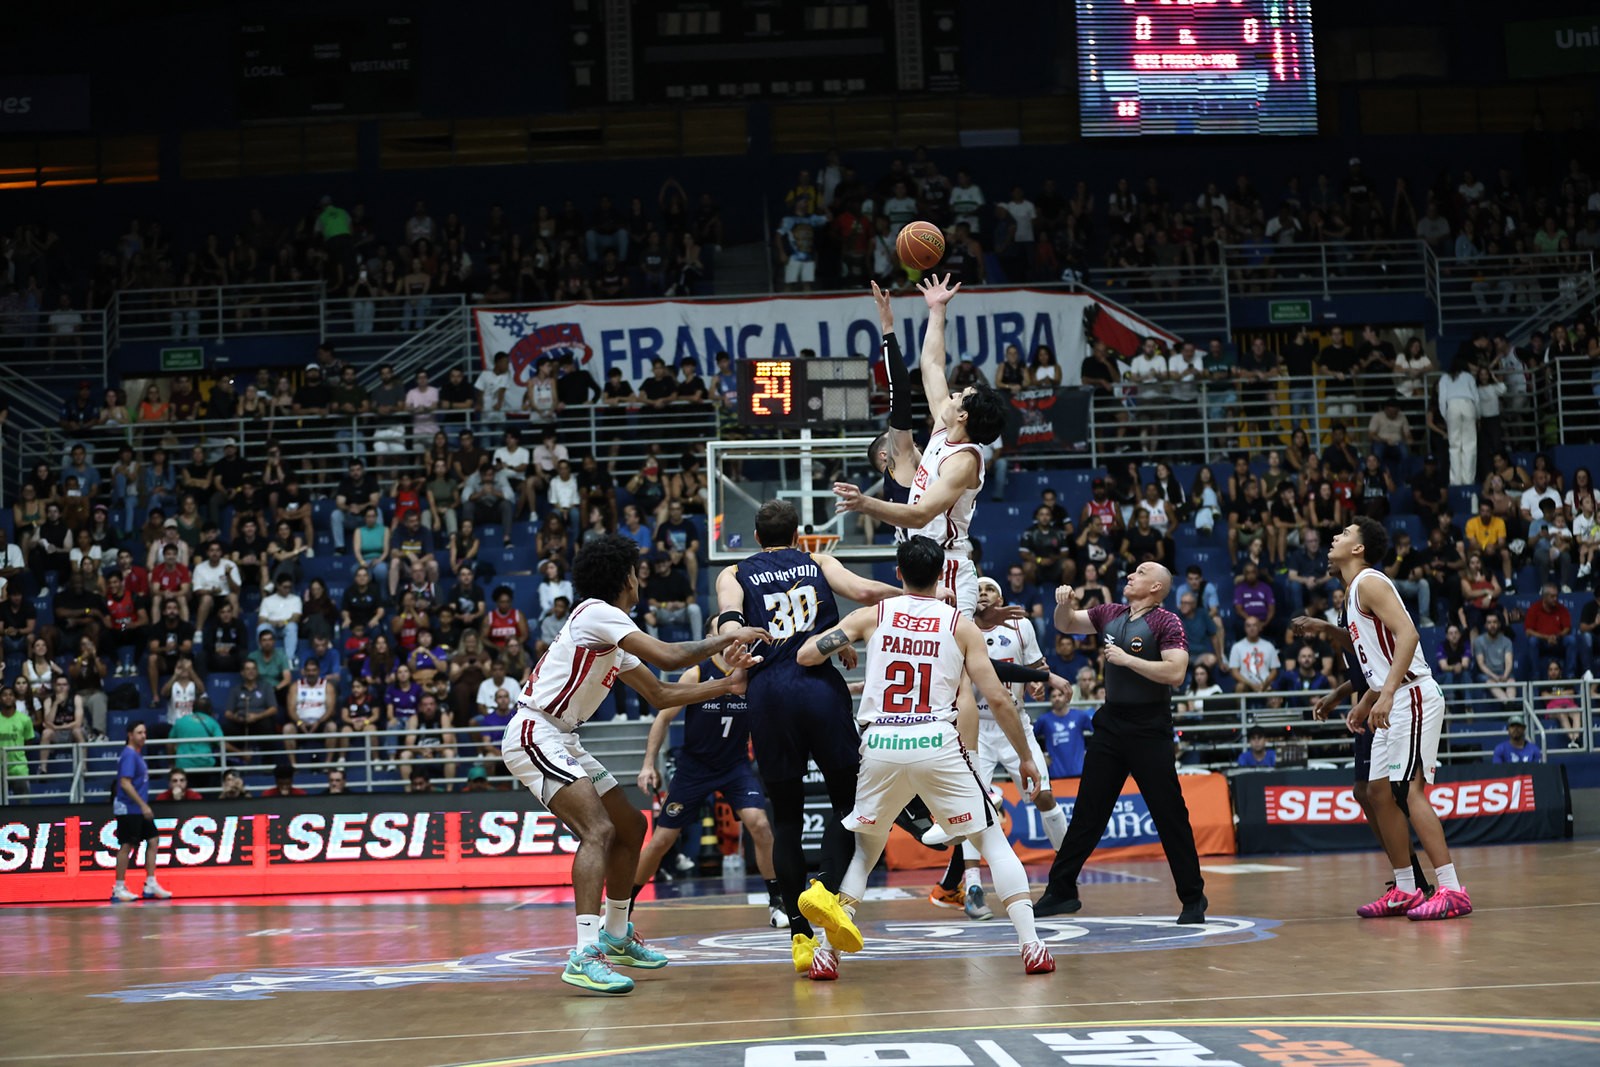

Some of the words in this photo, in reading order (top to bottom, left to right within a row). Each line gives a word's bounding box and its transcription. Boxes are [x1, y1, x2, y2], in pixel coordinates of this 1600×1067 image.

[1555, 25, 1600, 49] Uni
[243, 65, 286, 79] LOCAL
[350, 59, 412, 73] VISITANTE
[0, 95, 32, 114] es
[751, 377, 792, 416] 24
[763, 585, 819, 639] 30
[897, 614, 936, 631] SESI
[881, 635, 941, 657] PARODI
[1358, 644, 1368, 664] 6
[882, 660, 933, 714] 21
[720, 716, 733, 738] 7
[867, 732, 943, 751] Unimed
[1277, 789, 1366, 822] SES
[1429, 779, 1522, 818] SESI
[0, 821, 51, 872] SI
[283, 811, 430, 862] SESI
